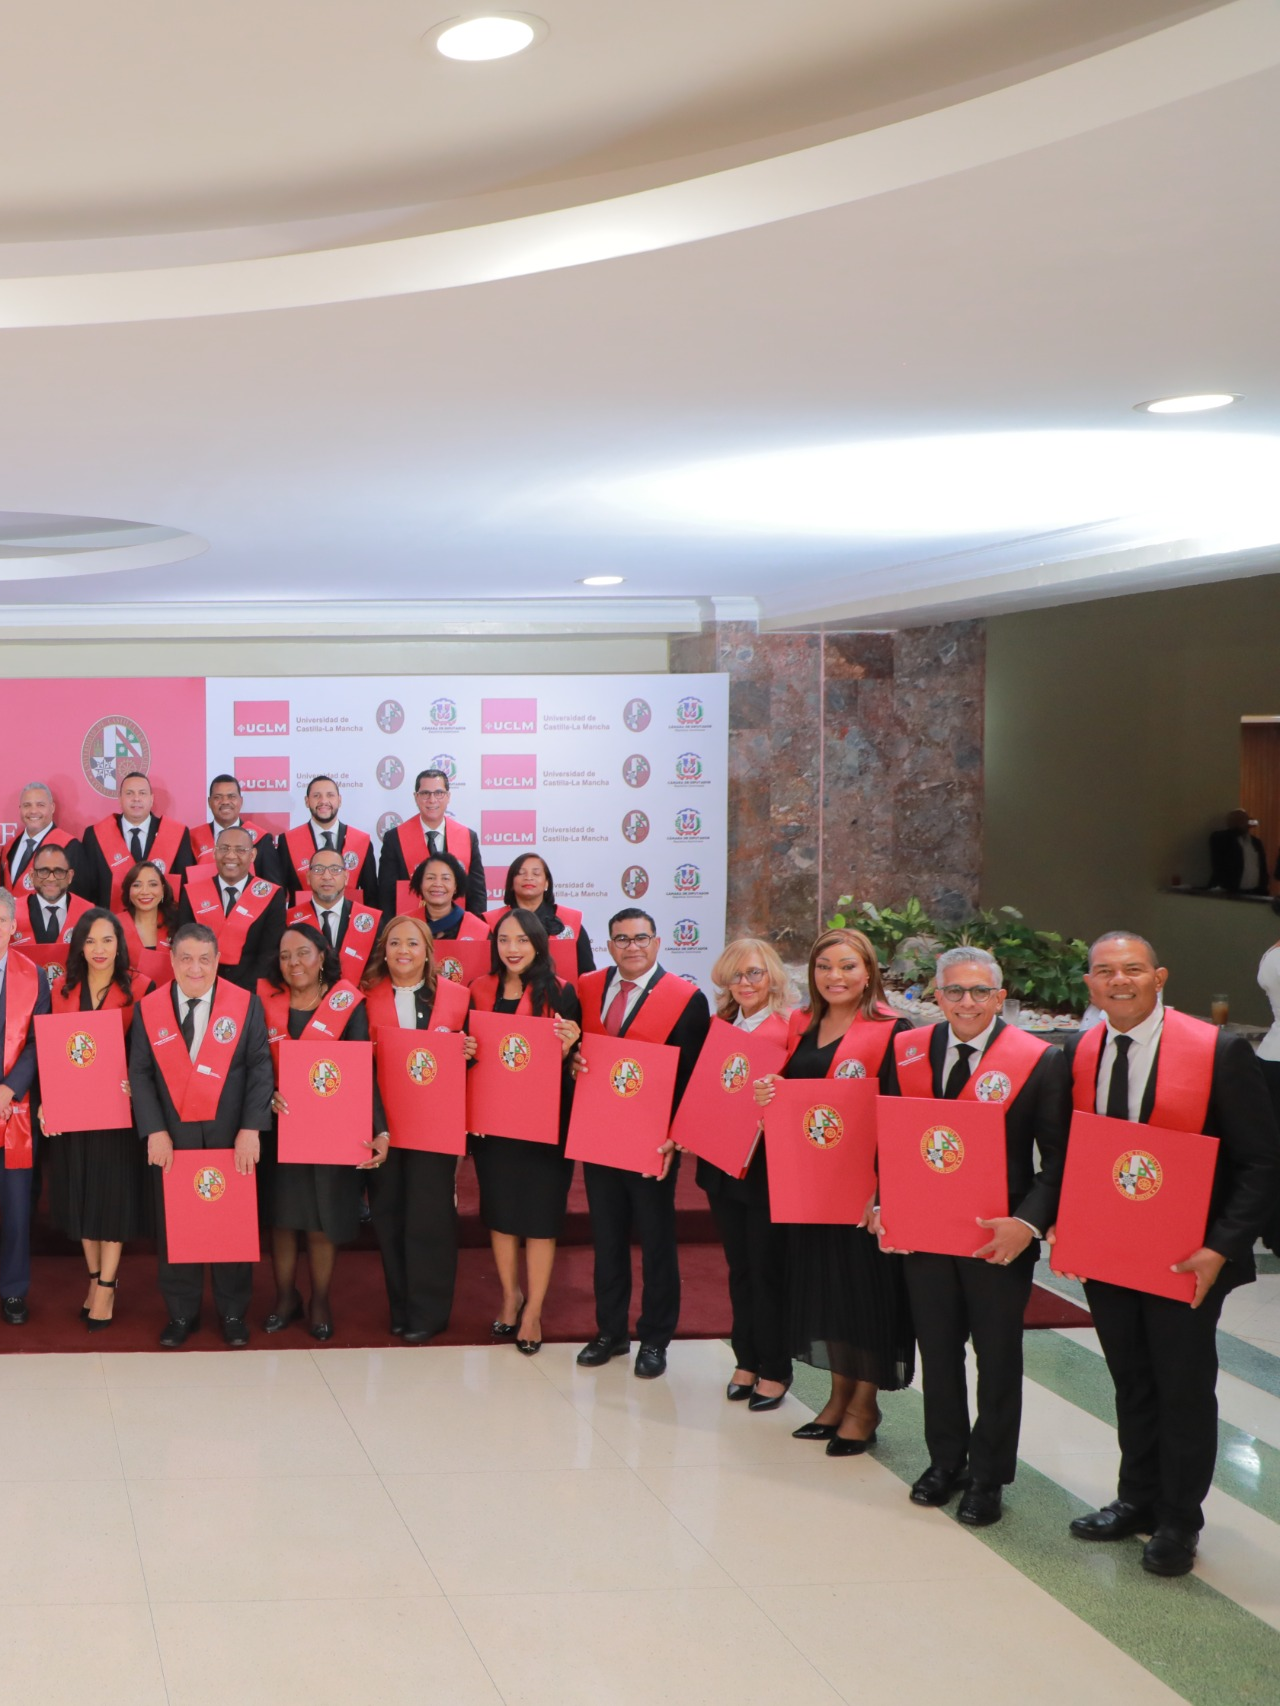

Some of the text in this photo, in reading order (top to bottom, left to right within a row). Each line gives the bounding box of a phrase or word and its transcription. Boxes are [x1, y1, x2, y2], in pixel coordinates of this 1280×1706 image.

[246, 723, 286, 733] UCLM
[494, 721, 534, 730] UCLM
[246, 779, 287, 789] UCLM
[494, 777, 534, 786] UCLM
[493, 832, 534, 842] UCLM
